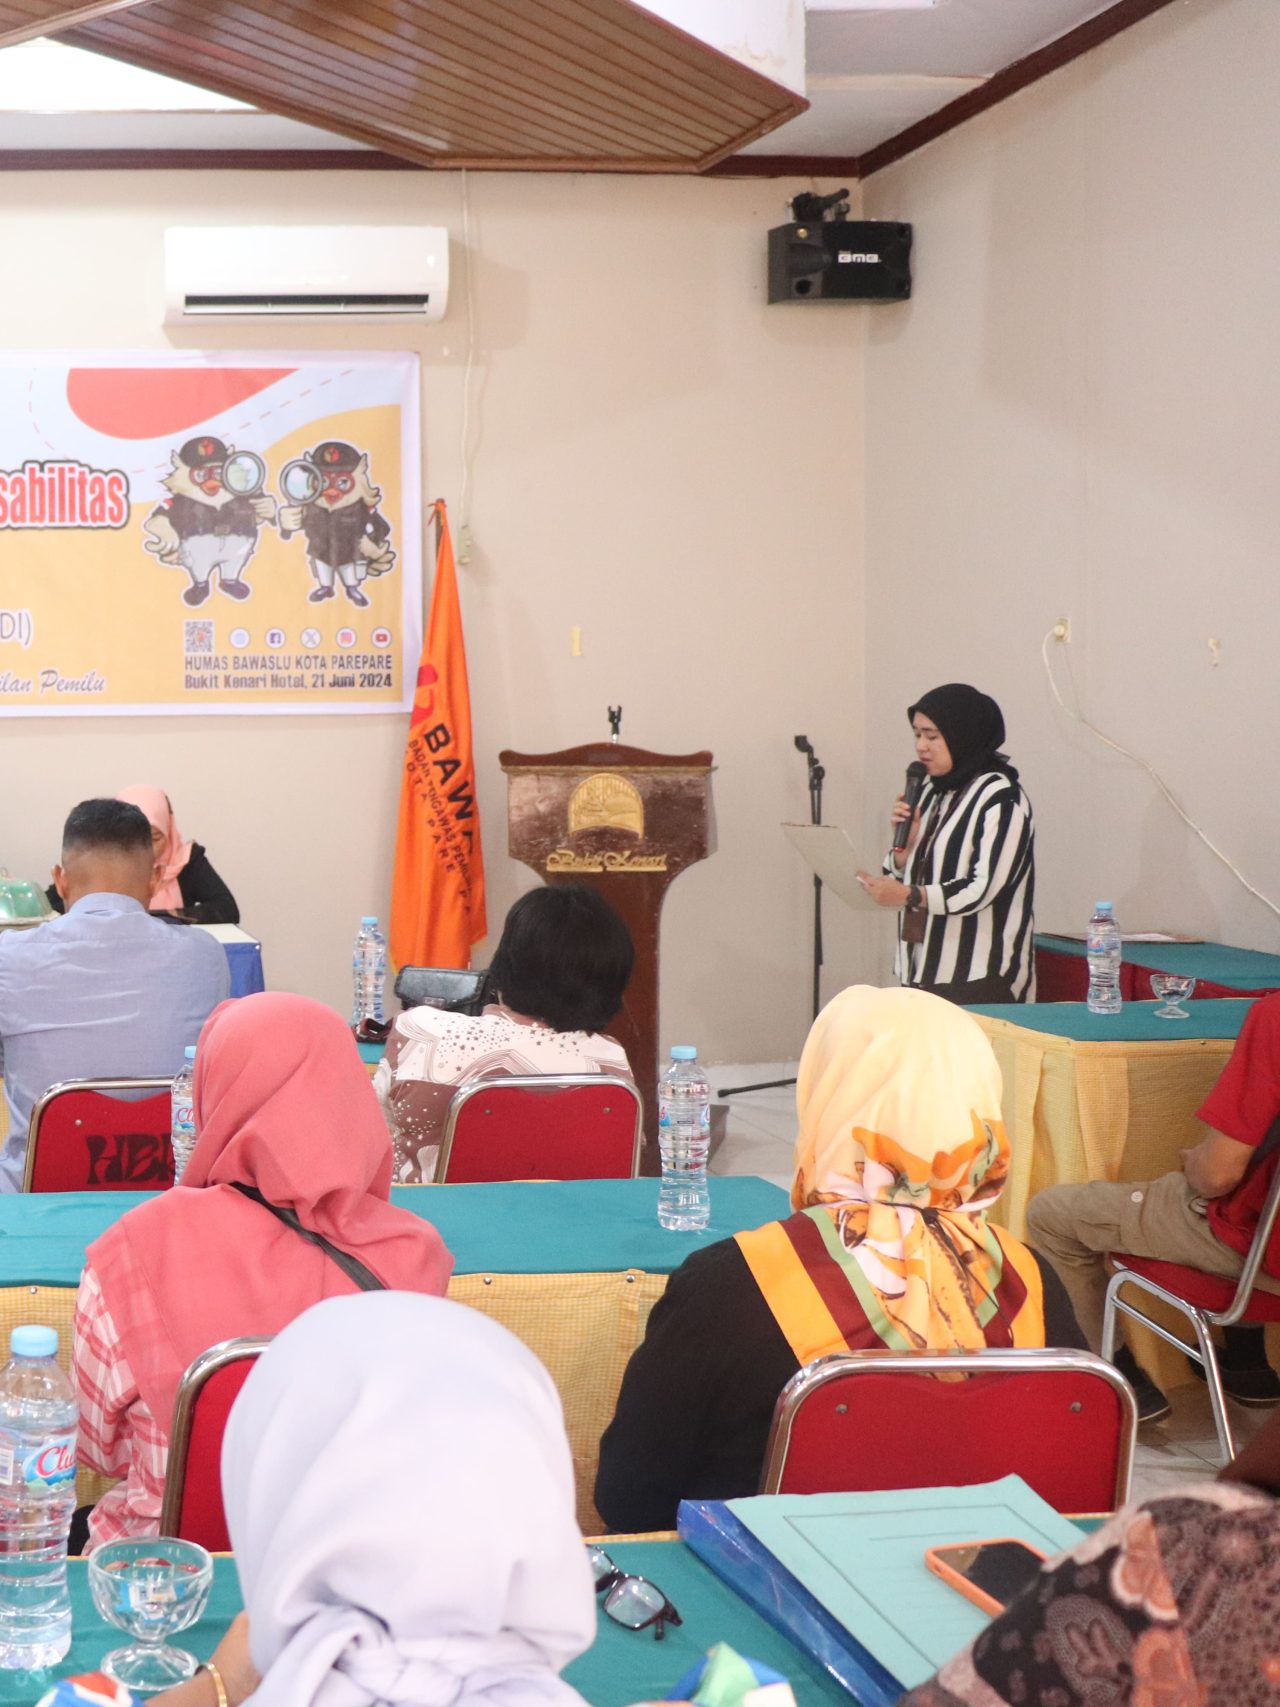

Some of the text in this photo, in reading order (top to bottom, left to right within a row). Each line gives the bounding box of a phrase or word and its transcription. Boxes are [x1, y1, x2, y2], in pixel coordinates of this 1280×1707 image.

[185, 654, 392, 671] HUMAS BAWASLU KOTA PAREPARE
[40, 668, 105, 693] Pemilu
[185, 674, 219, 689] Bukit
[224, 673, 267, 688] Kenari
[312, 673, 324, 688] 21
[329, 673, 355, 688] Juni
[359, 673, 392, 688] 2024
